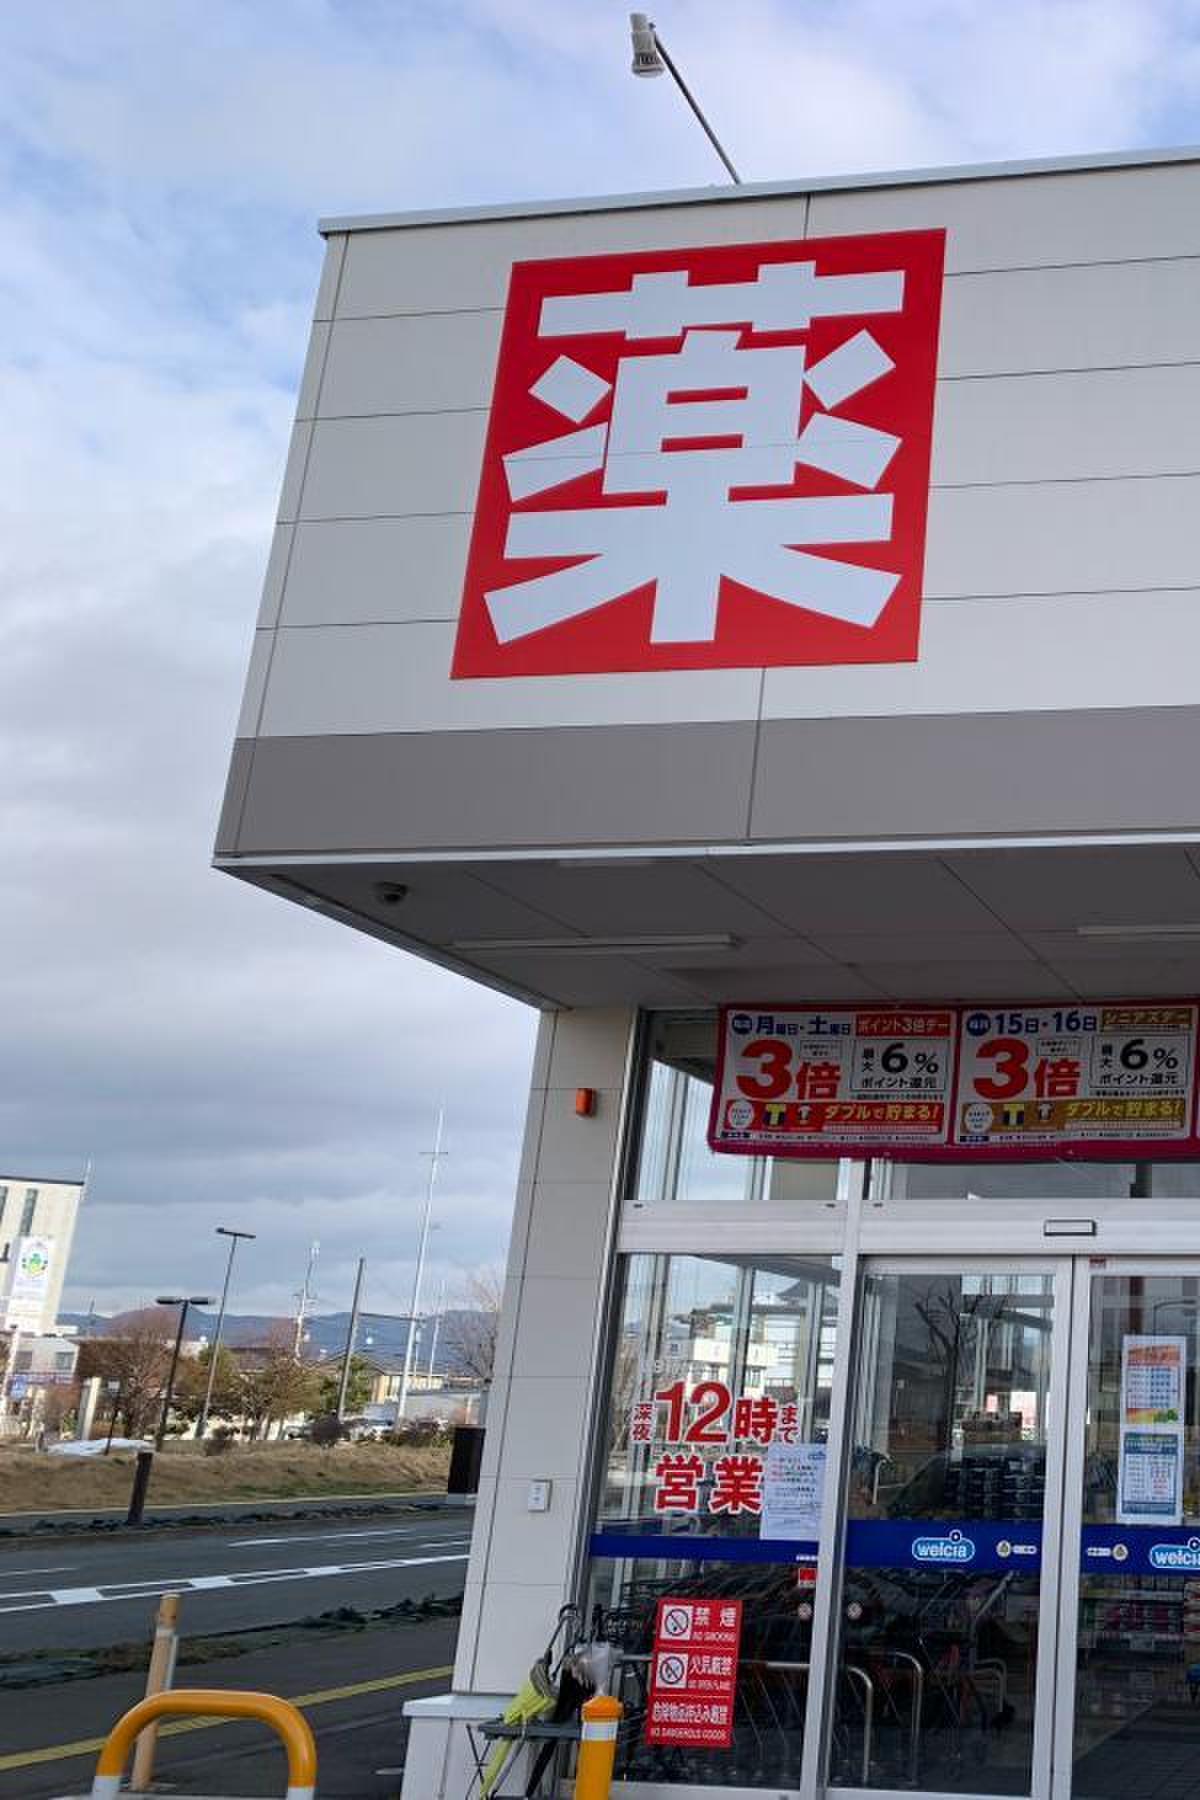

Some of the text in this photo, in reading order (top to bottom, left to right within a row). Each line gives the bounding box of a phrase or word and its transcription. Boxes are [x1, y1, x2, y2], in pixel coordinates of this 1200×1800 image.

[484, 260, 905, 645] 薬
[756, 1015, 851, 1036] 月曜日・土曜日
[857, 1017, 949, 1034] ポイント3倍デー
[995, 1010, 1097, 1034] 15日・16日
[881, 1042, 939, 1075] 6%
[1120, 1038, 1179, 1070] 6%
[736, 1038, 842, 1100] 3倍
[973, 1037, 1080, 1100] 3倍
[1100, 1072, 1179, 1086] ポイント還元
[861, 1076, 937, 1089] ポイント還元
[631, 1403, 653, 1441] 深夜
[655, 1454, 763, 1513] 営業
[917, 1541, 967, 1559] welcia
[694, 1607, 737, 1627] 禁煙
[689, 1655, 733, 1676] 火気厳禁
